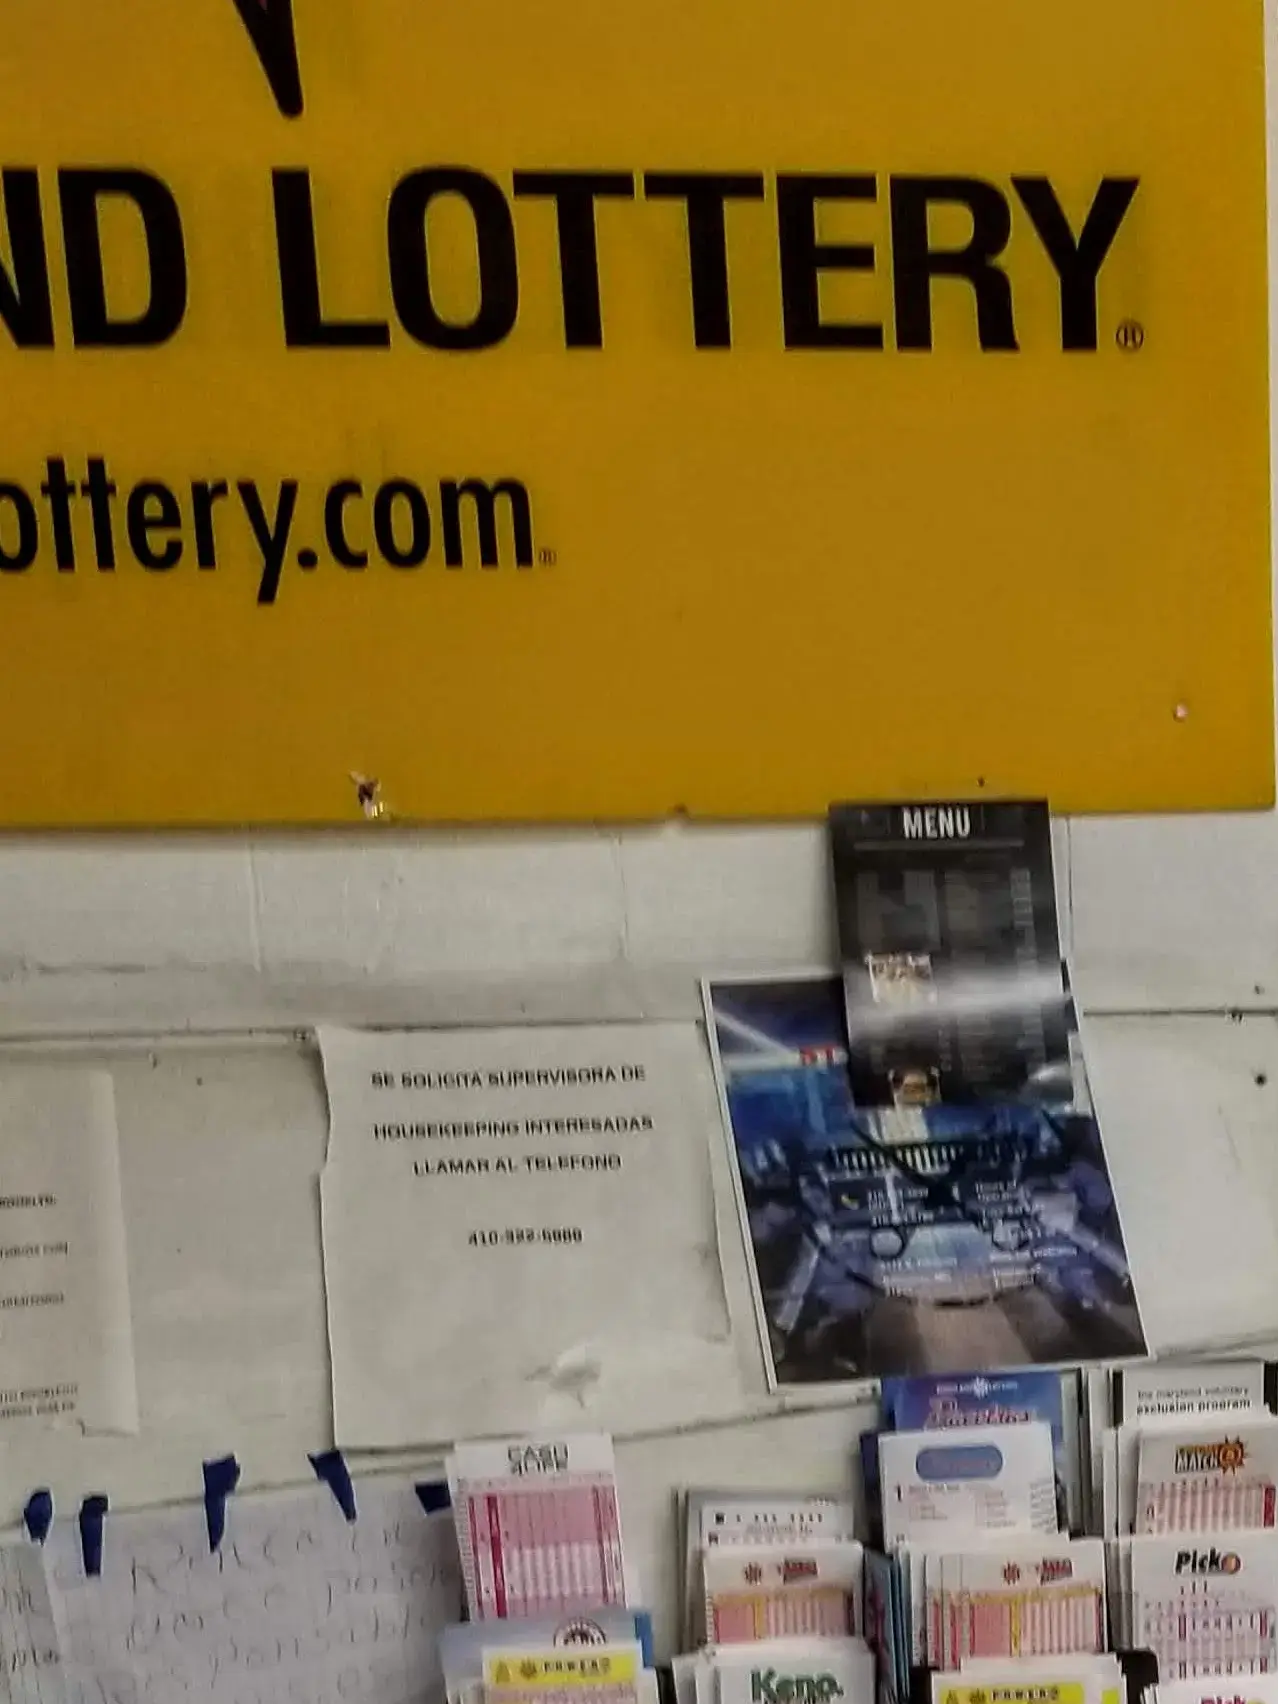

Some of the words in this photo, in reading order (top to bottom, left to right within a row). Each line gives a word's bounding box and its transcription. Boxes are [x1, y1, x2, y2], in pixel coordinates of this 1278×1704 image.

[902, 807, 971, 840] MENU
[487, 1065, 618, 1089] SUPERVISORA
[495, 1155, 517, 1174] AL
[522, 1152, 623, 1174] TELEFONO
